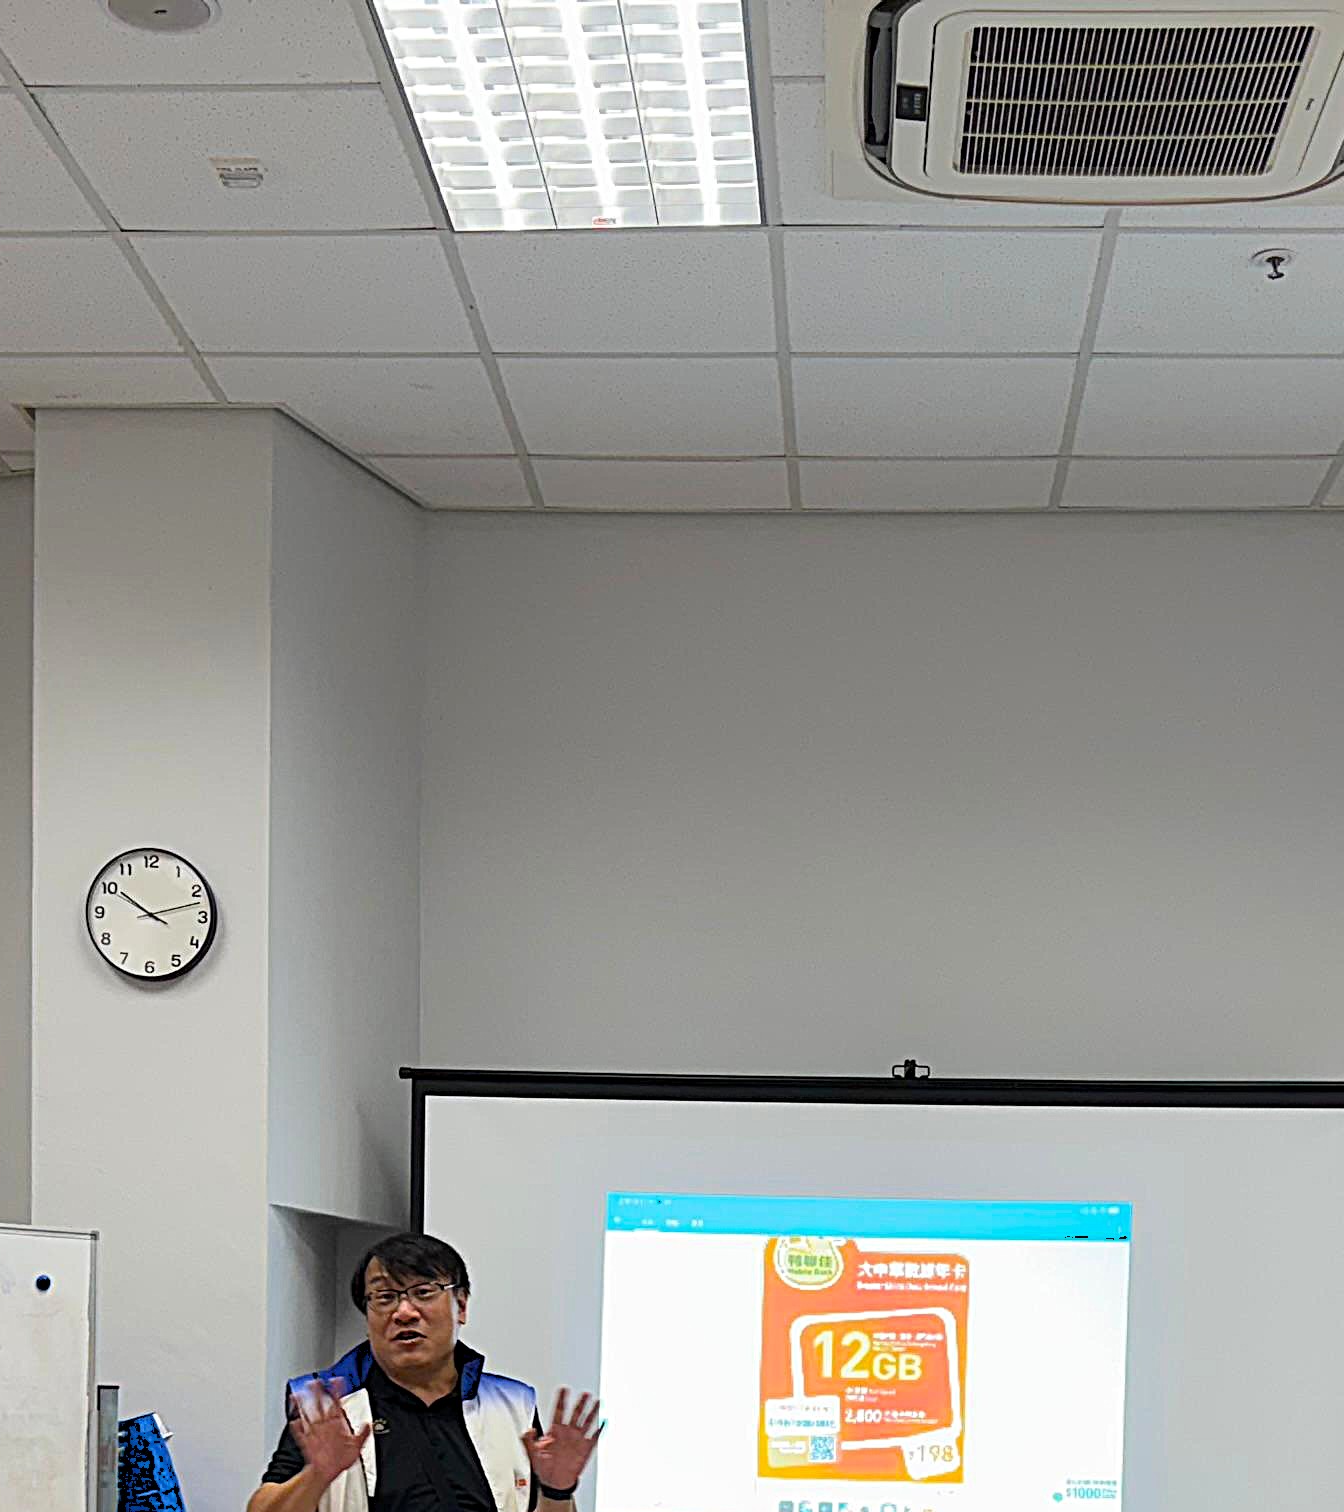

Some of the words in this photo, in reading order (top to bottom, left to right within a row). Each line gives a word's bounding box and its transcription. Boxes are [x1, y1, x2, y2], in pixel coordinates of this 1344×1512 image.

[144, 855, 159, 868] 12
[120, 863, 132, 875] 11
[176, 865, 181, 877] 1
[102, 881, 118, 895] 10
[191, 884, 202, 898] 2
[94, 906, 105, 919] 9
[198, 911, 208, 924] 3
[101, 932, 111, 945] 8
[190, 936, 199, 949] 4
[120, 952, 129, 964] 7
[171, 954, 181, 967] 5
[144, 961, 155, 974] 6
